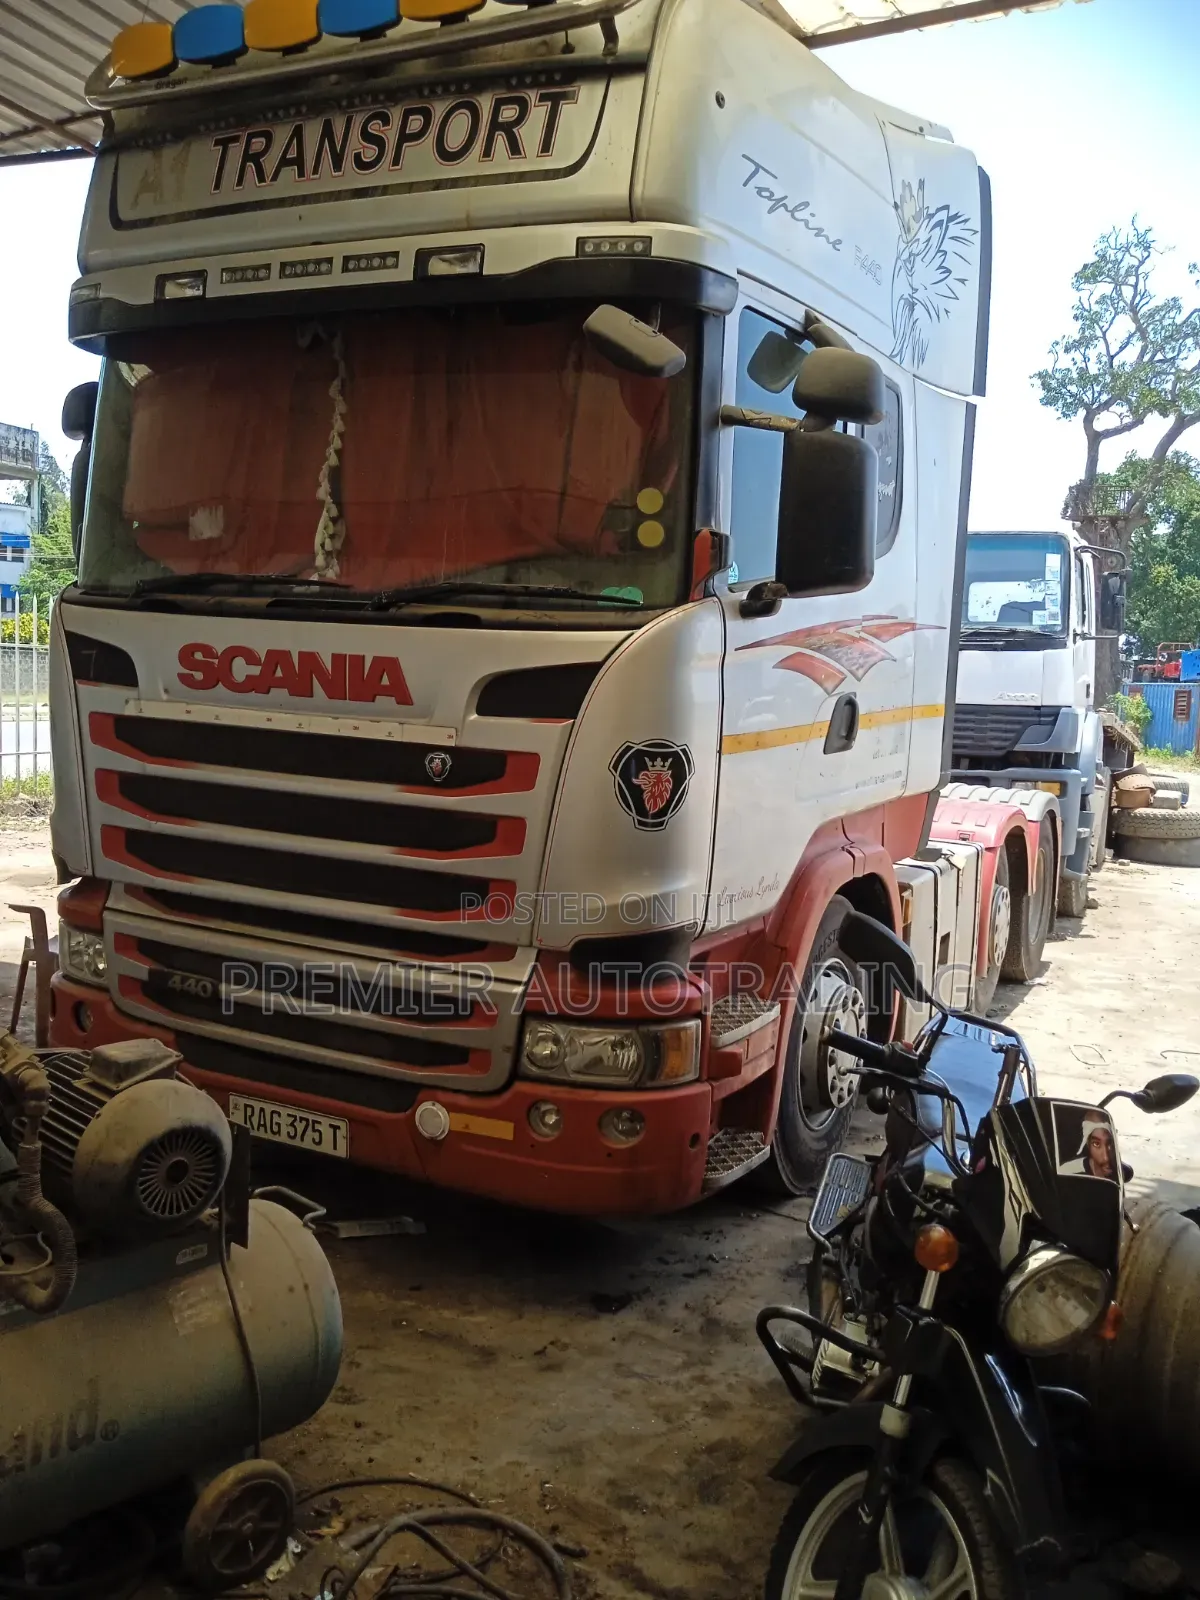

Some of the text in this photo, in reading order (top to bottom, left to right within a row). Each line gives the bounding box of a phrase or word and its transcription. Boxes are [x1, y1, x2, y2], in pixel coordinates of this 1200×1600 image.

[209, 86, 581, 195] TRANSPORT
[741, 153, 843, 252] Topline
[176, 642, 414, 706] SCANIA
[167, 974, 213, 998] 440
[243, 1103, 341, 1151] RAG 375 T
